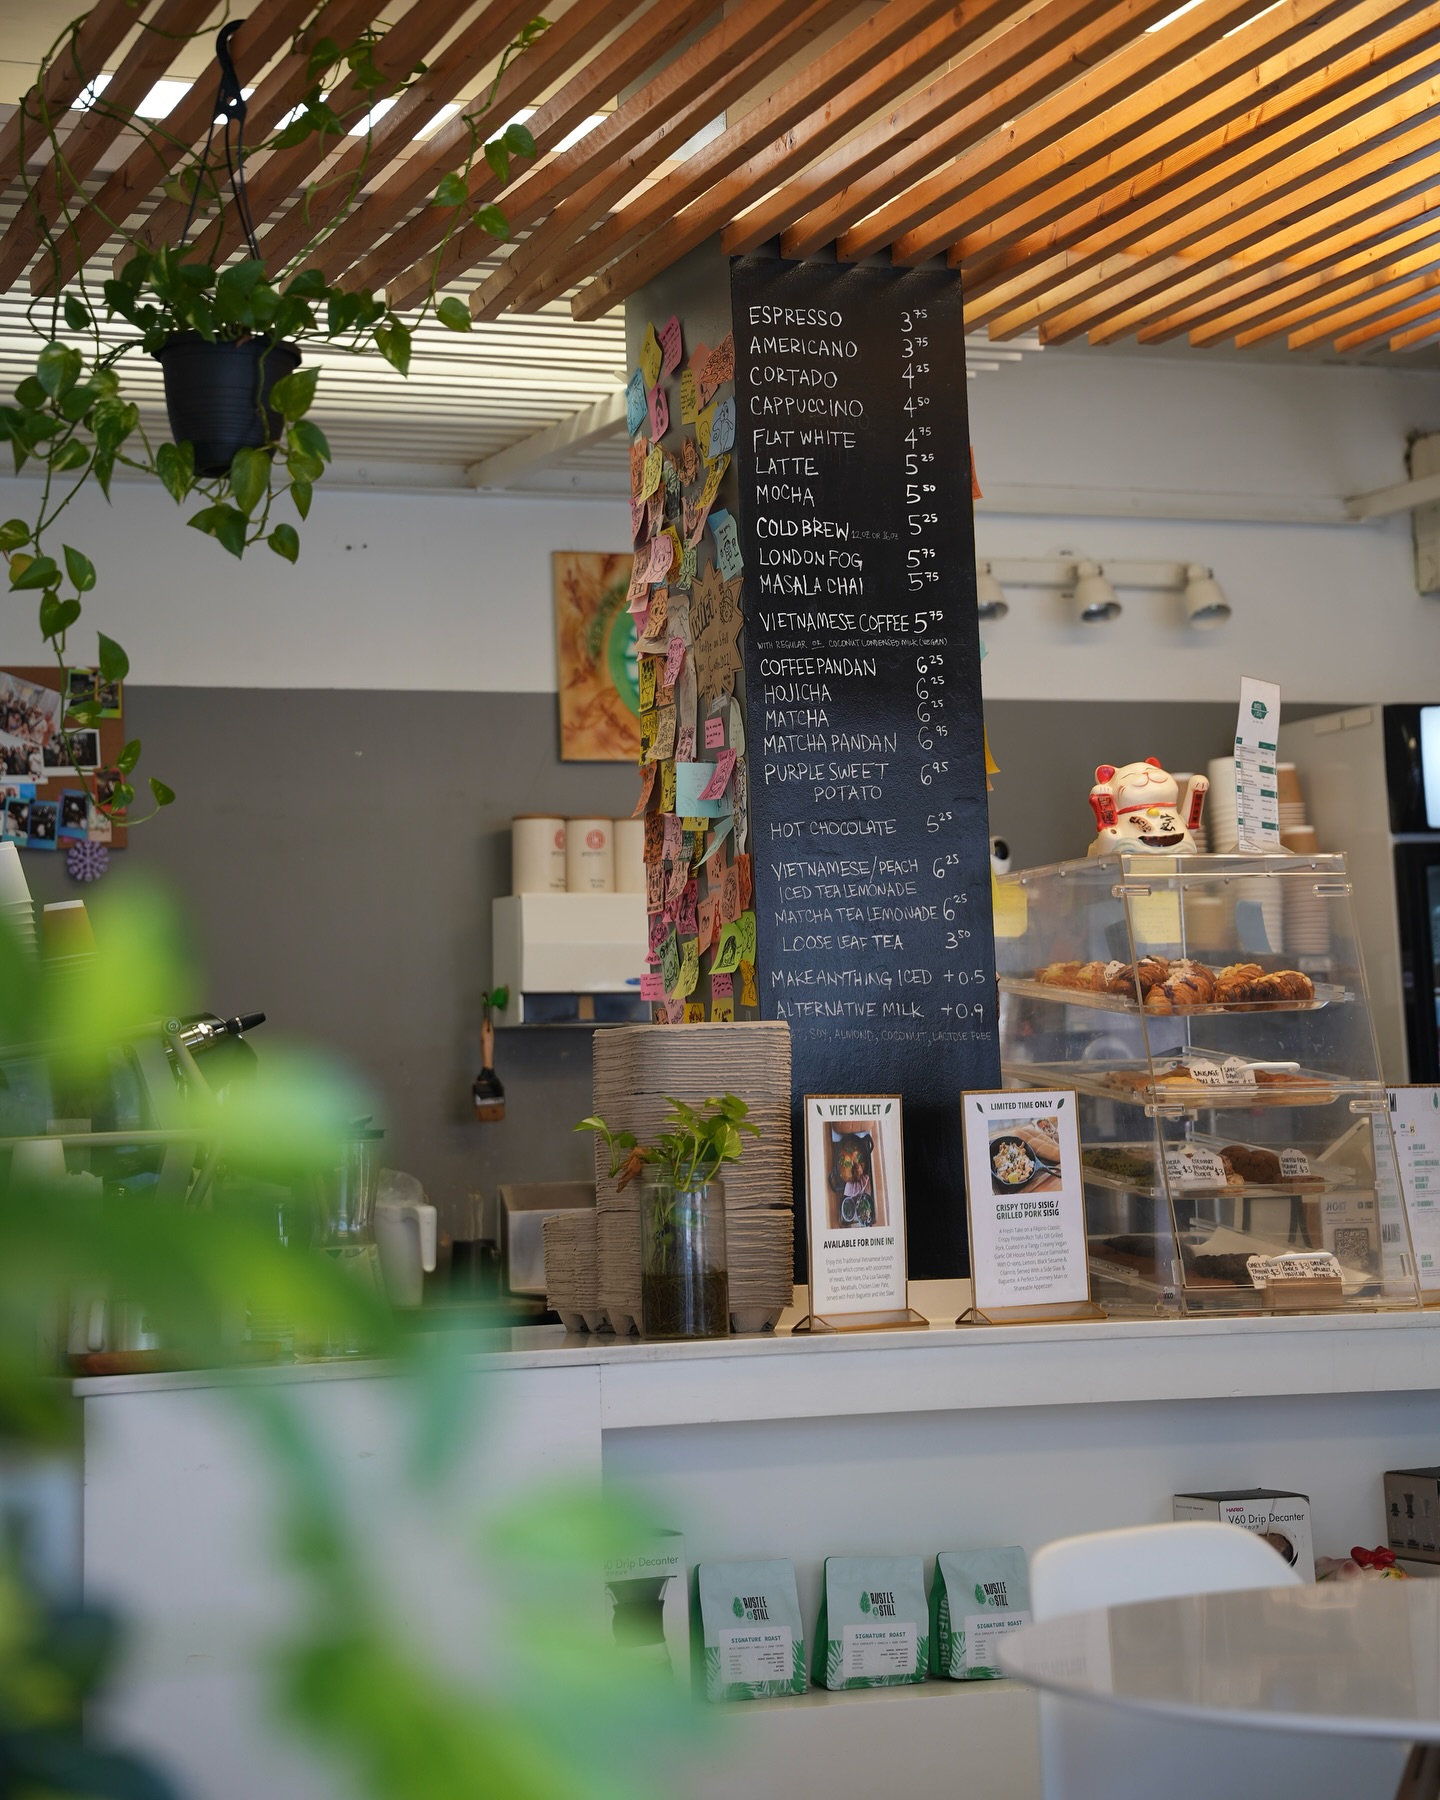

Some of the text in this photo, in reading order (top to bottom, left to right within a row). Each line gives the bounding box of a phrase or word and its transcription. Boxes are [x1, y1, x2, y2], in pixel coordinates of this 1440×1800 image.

[749, 306, 842, 326] ESPRESSO
[750, 336, 857, 358] AMERICANO
[750, 367, 837, 388] CORTADO
[750, 396, 863, 417] CAPPUCCINO
[753, 429, 794, 452] FLAT
[800, 430, 856, 448] WHITE
[756, 458, 818, 475] LATTE
[757, 484, 815, 507] MOCHA
[757, 517, 798, 539] COLD
[802, 517, 848, 541] BREW
[759, 548, 825, 566] LONDON
[829, 550, 863, 571] FOG
[760, 574, 822, 595] MASALA
[827, 577, 863, 595] CHAI
[759, 612, 854, 631] VIETNAMESE
[859, 614, 909, 632] COFFEE
[757, 641, 773, 649] WITH
[776, 641, 807, 649] REGULAR
[829, 639, 859, 647] COCONUT
[862, 639, 900, 647] CONDENSED
[760, 658, 813, 676] COFFEE
[817, 658, 876, 676] PANDAN
[764, 683, 832, 704] HOJICHA
[766, 710, 829, 730] MATCHA
[764, 734, 827, 755] MATCHA
[832, 733, 897, 753] PANDAN
[765, 763, 824, 784] PURPLE
[830, 763, 889, 781] SWEET
[815, 786, 882, 802] POTATO
[771, 822, 805, 840] HOT
[810, 819, 896, 836] CHOCOLATE
[780, 882, 917, 903] ICED TEA LEMONADE
[775, 908, 833, 926] MATCHA
[836, 908, 864, 922] TEA
[867, 906, 938, 922] LEMONADE
[783, 936, 832, 952] LOOSE
[838, 936, 867, 949] LEAF
[872, 935, 903, 950] TEA
[772, 970, 813, 987] MAKE
[817, 970, 892, 990] ANYTHING
[899, 970, 932, 986] ICED
[777, 1001, 876, 1019] ALTERNATIVE
[883, 1002, 924, 1018] MILK
[830, 1104, 881, 1115] VIET SKILLET
[991, 1102, 1016, 1110] LIMITED
[1018, 1101, 1033, 1109] TIME
[996, 1203, 1018, 1212] CRISPY
[1020, 1202, 1037, 1210] TOFU
[1038, 1201, 1054, 1209] SISIG
[997, 1211, 1023, 1220] GRILLED
[1024, 1210, 1042, 1218] PORK
[824, 1239, 856, 1249] AVAILABLE
[870, 1238, 884, 1246] DINE
[886, 1237, 894, 1245] IN!
[1228, 1512, 1304, 1524] V60 Drip Decanter
[639, 1556, 678, 1567] Decanter
[984, 1582, 1006, 1595] RUSTLE
[743, 1596, 767, 1608] RUSTLE
[870, 1592, 894, 1604] RUSTLE
[994, 1594, 1008, 1606] STILL
[752, 1609, 769, 1620] STILL
[878, 1604, 896, 1616] STILL
